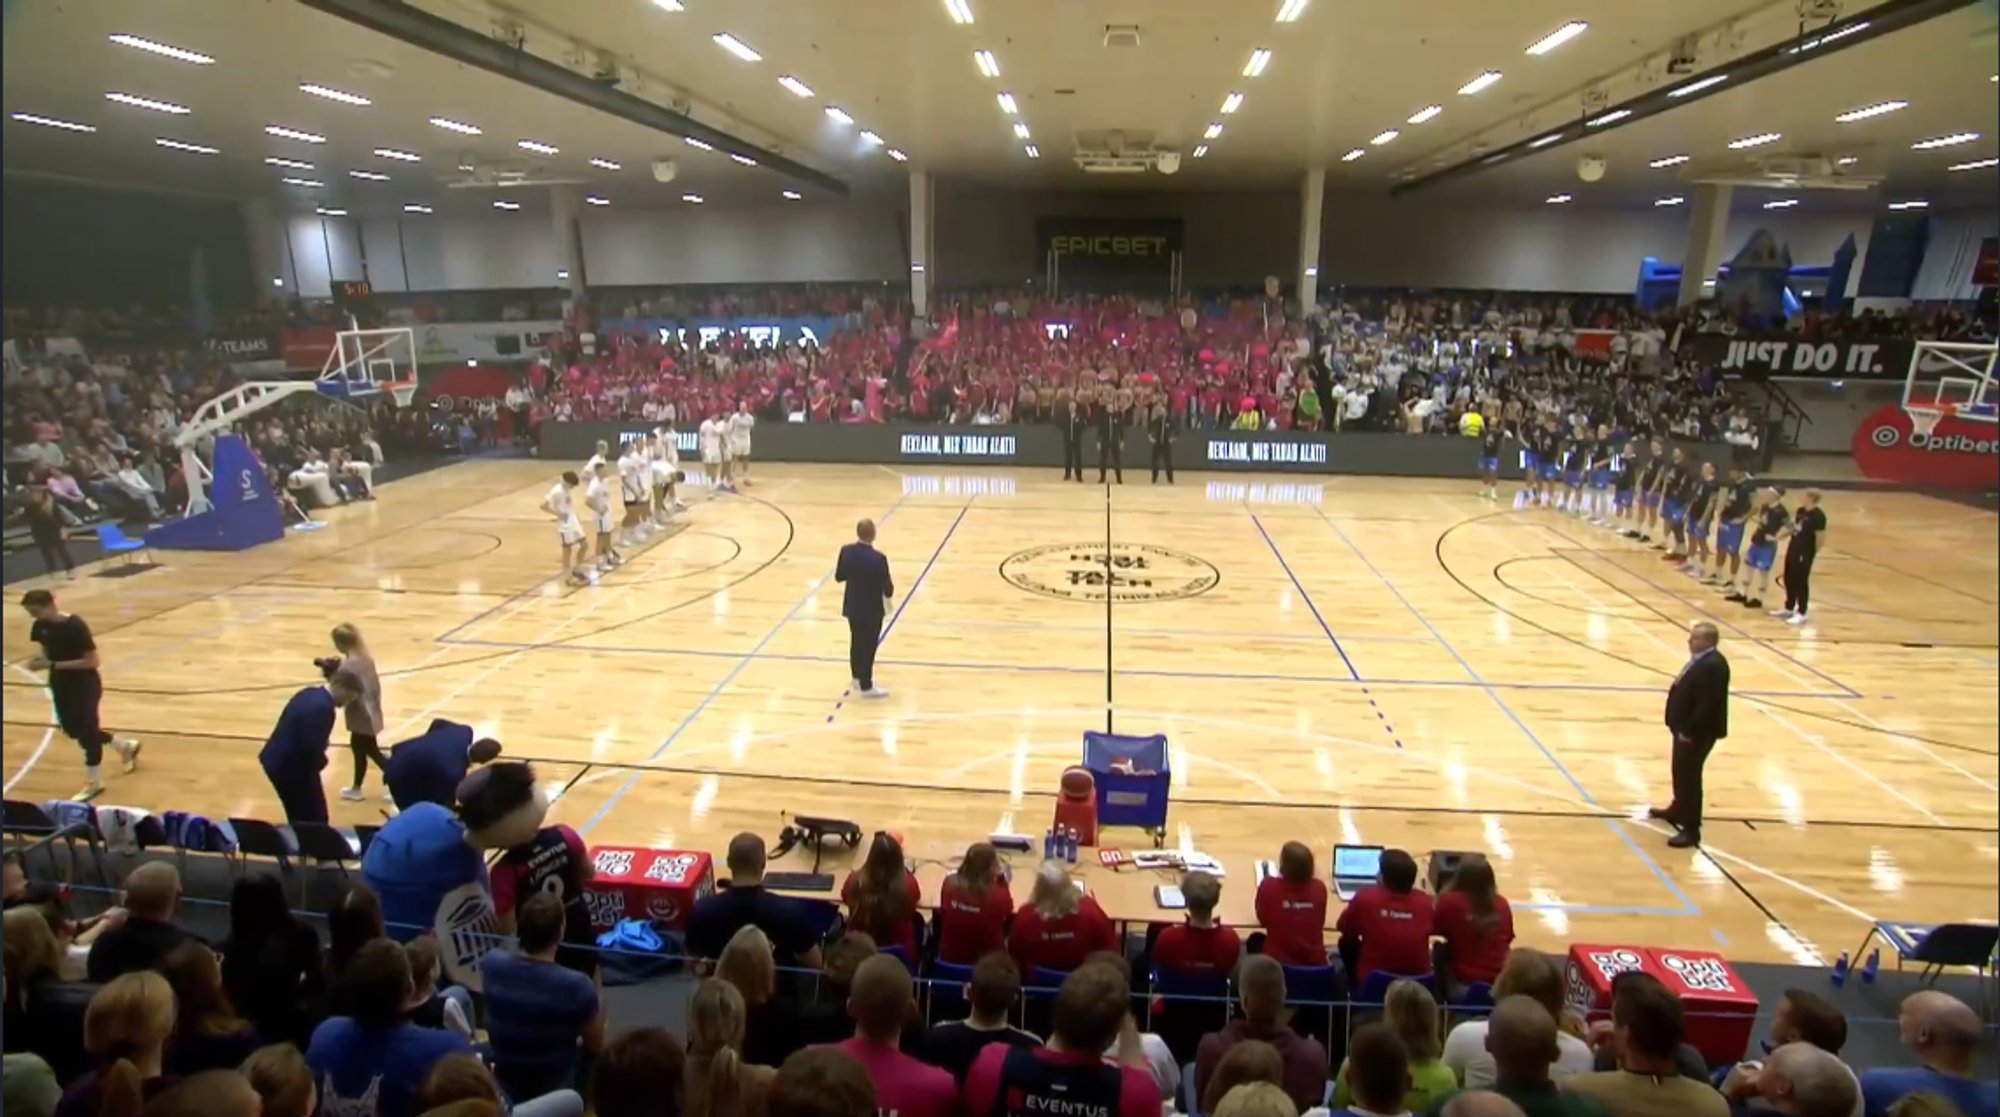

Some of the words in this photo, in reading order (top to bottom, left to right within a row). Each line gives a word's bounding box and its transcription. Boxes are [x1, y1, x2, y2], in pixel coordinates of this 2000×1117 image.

[1051, 236, 1167, 256] EPICBET
[1792, 342, 1839, 372] DO
[1845, 344, 1884, 374] IT.
[1908, 432, 1999, 454] Optibet
[1664, 955, 1726, 976] Opti
[1681, 970, 1734, 991] bet
[1025, 1094, 1108, 1117] EVENTUS
